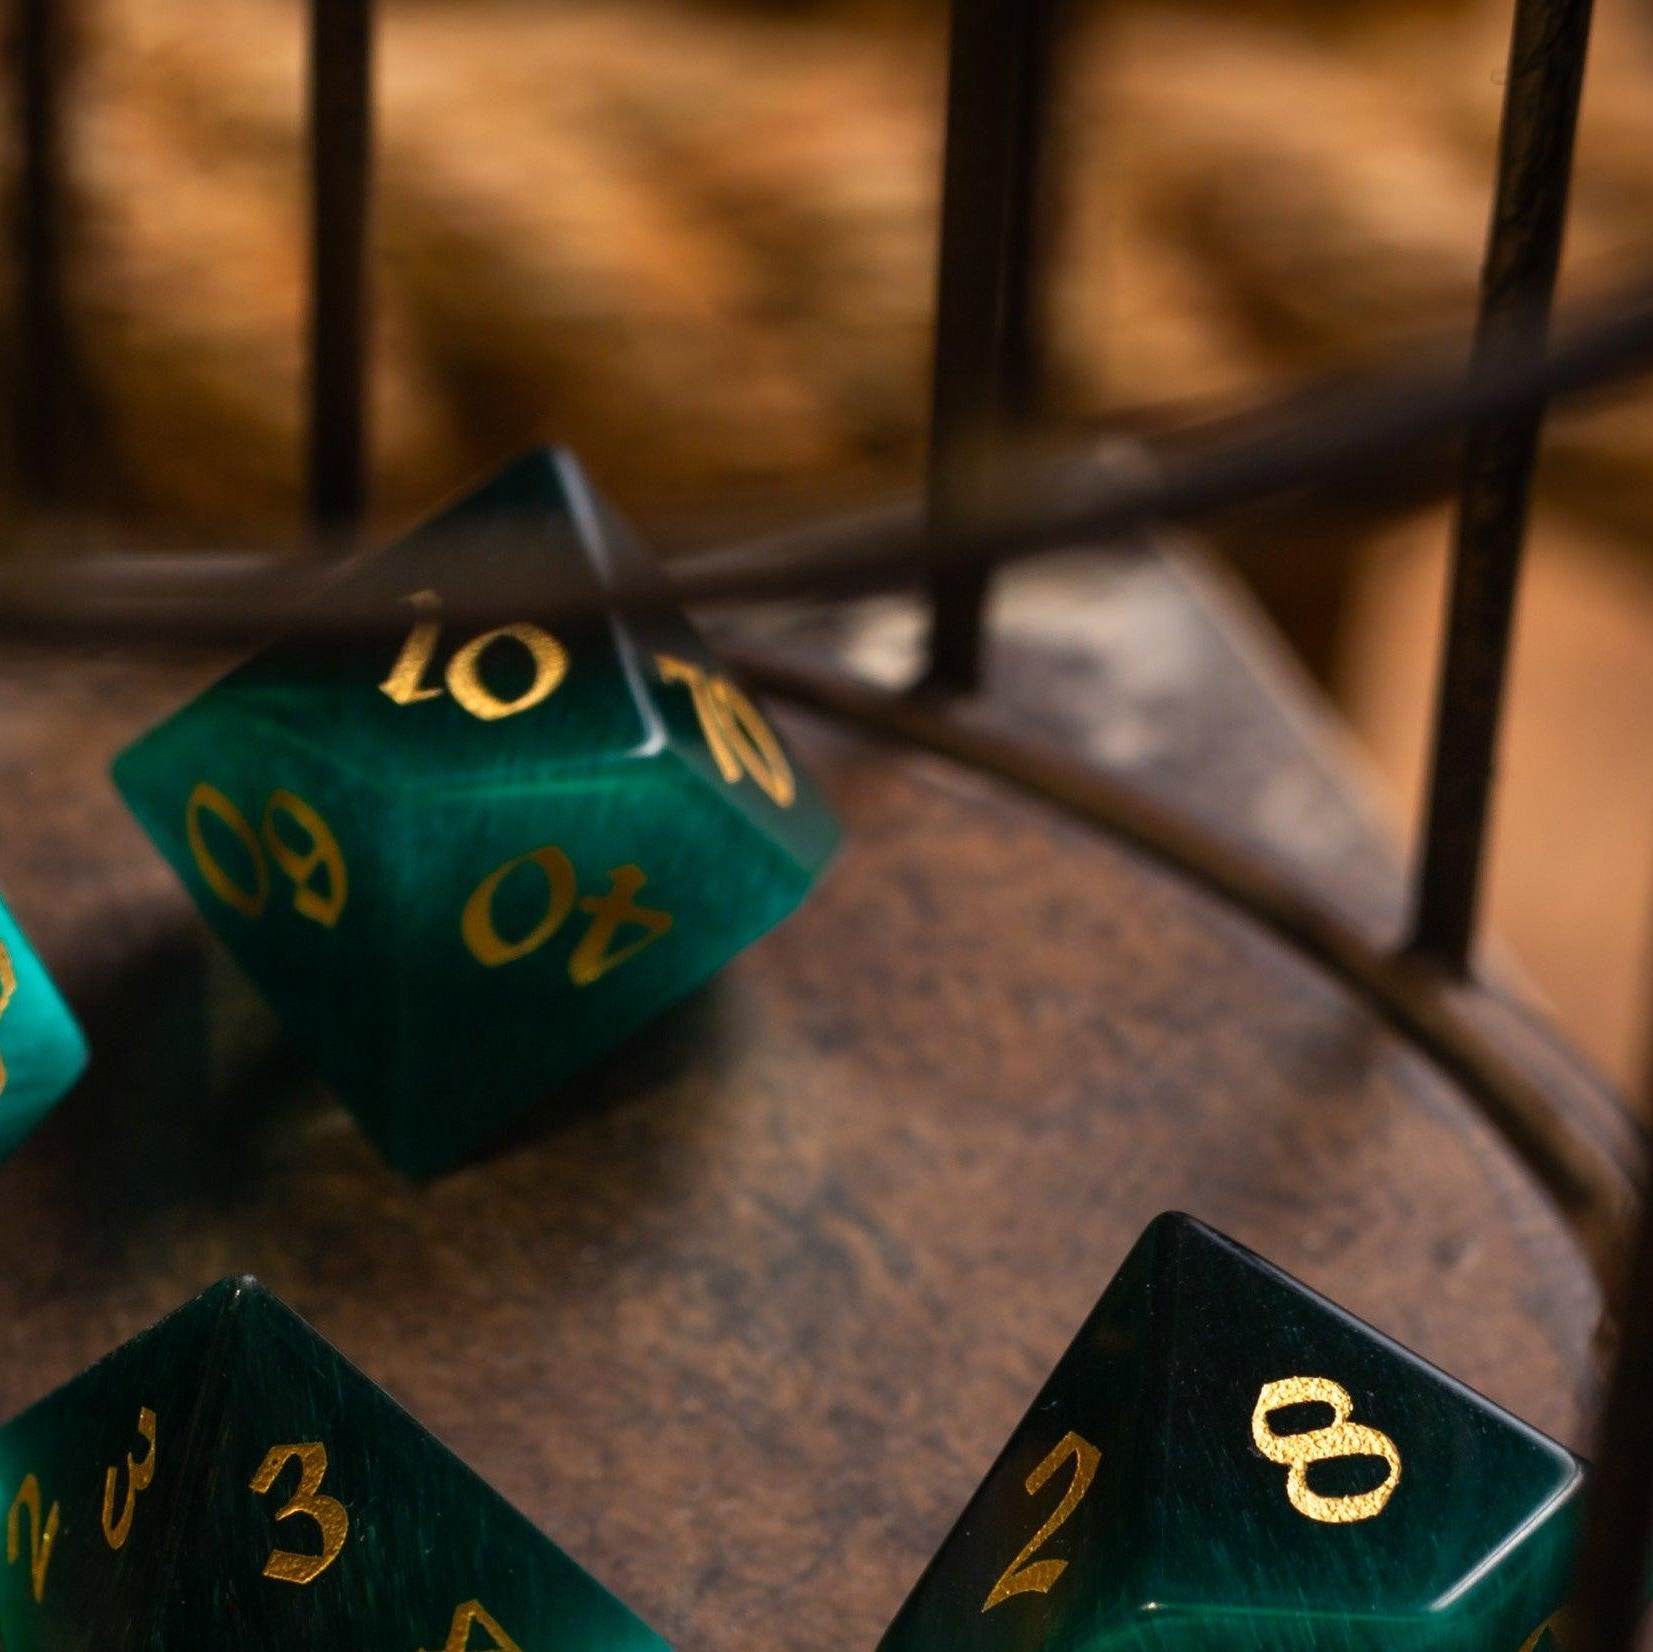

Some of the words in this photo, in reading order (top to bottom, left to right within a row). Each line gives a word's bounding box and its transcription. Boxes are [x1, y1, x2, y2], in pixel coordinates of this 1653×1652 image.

[191, 786, 344, 923] 60
[464, 849, 670, 982] 40
[101, 1408, 156, 1549] 3
[250, 1443, 348, 1585] 3
[1251, 1376, 1403, 1524] 8
[982, 1431, 1102, 1613] 2
